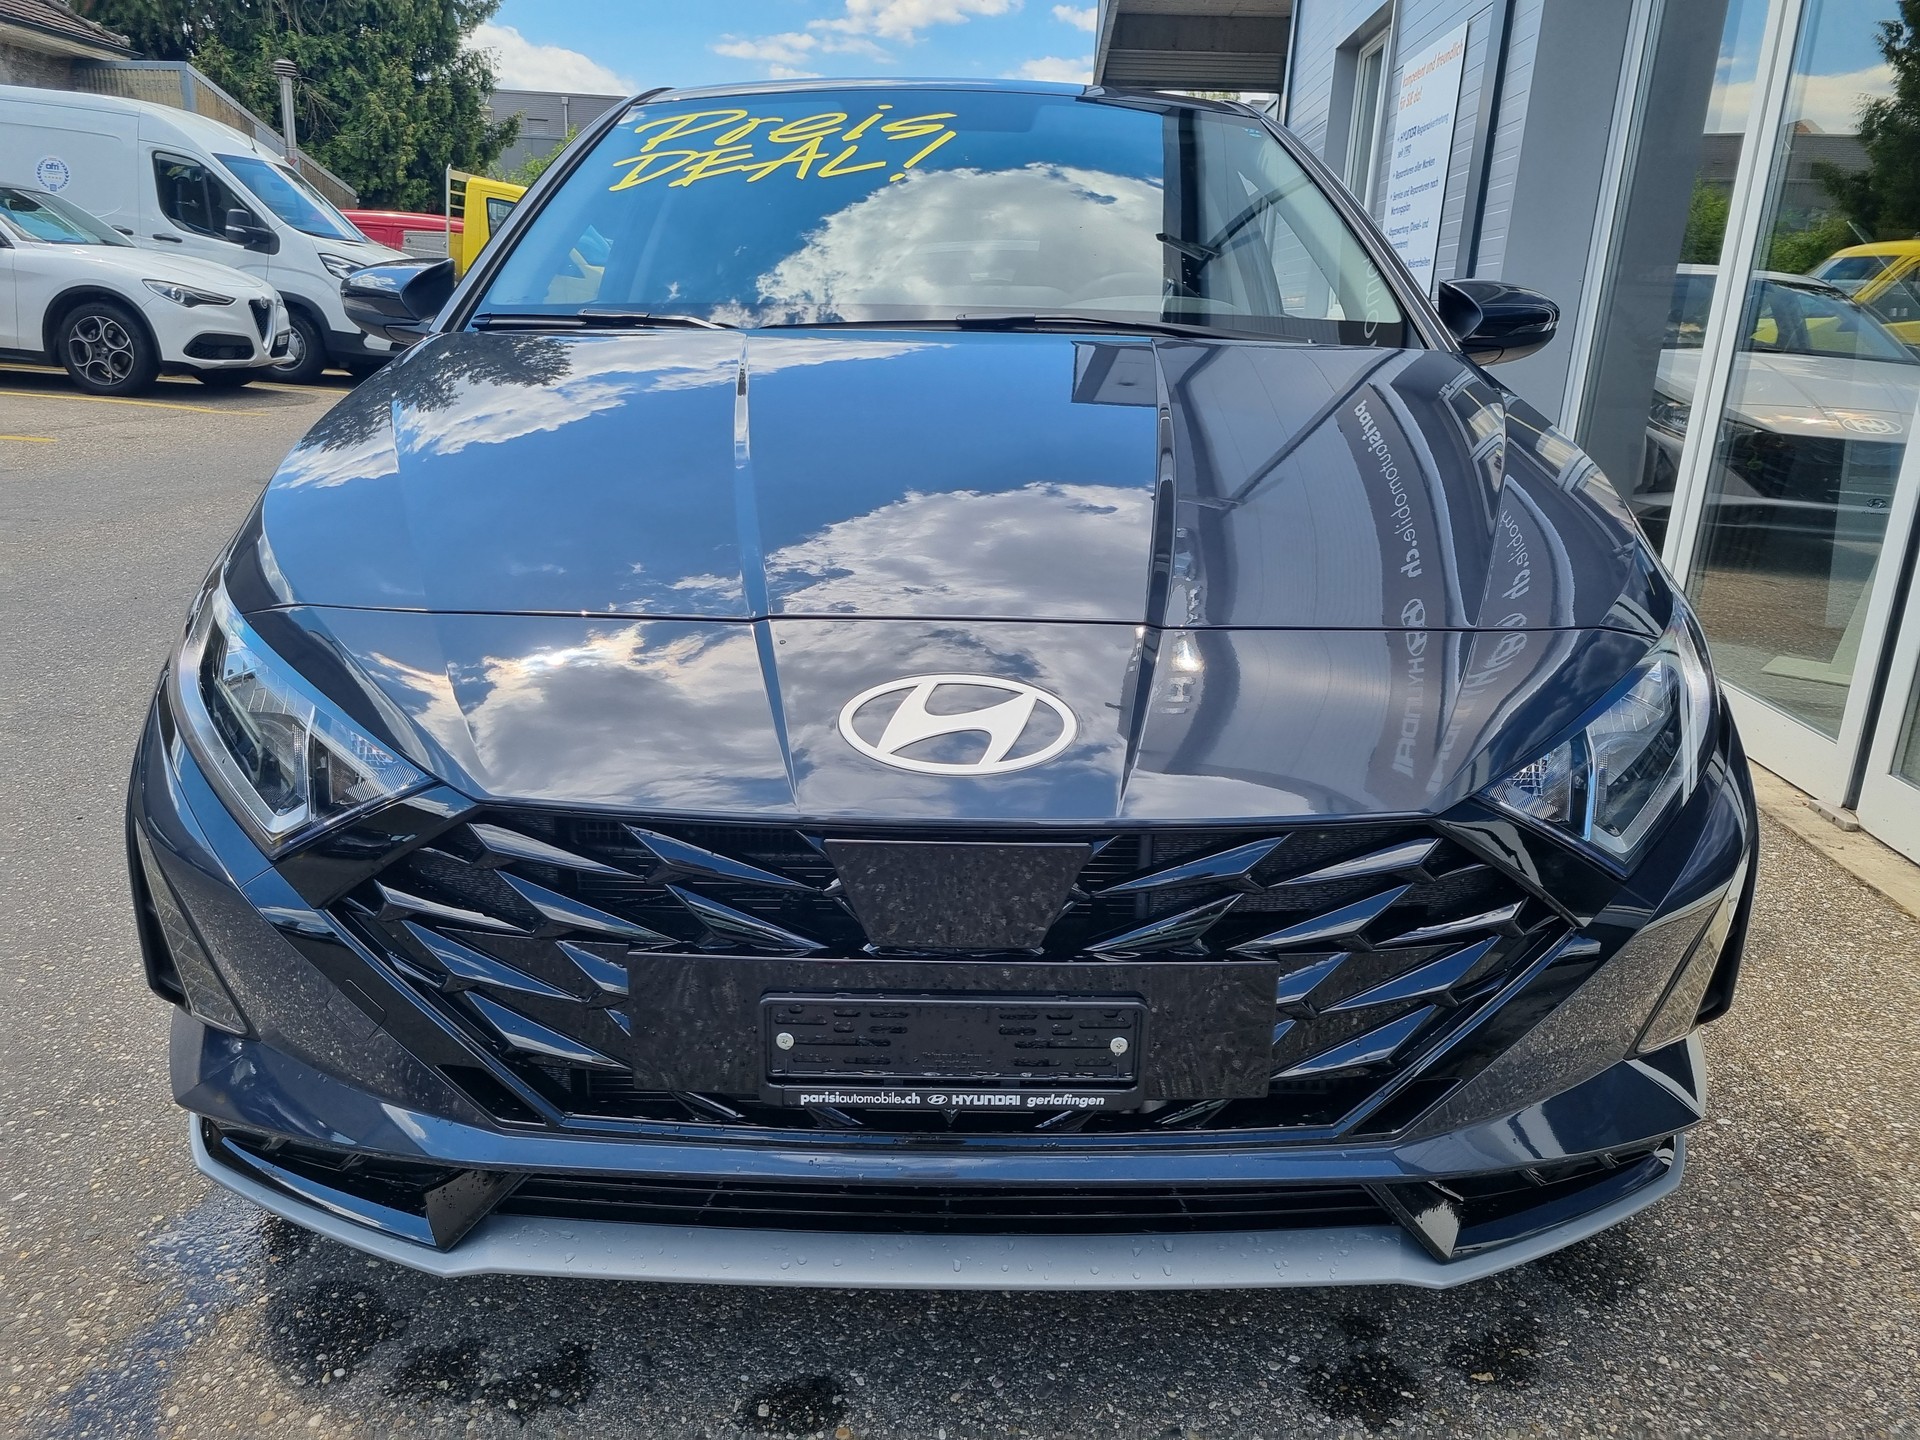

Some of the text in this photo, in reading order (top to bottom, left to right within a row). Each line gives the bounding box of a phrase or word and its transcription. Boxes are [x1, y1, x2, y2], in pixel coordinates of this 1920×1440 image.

[1435, 38, 1464, 69] freundlich
[634, 104, 957, 152] Preis
[609, 131, 956, 191] DEAL!
[800, 1091, 1105, 1108] parisiautomobile.ch HYUNDAI gerlafingen
